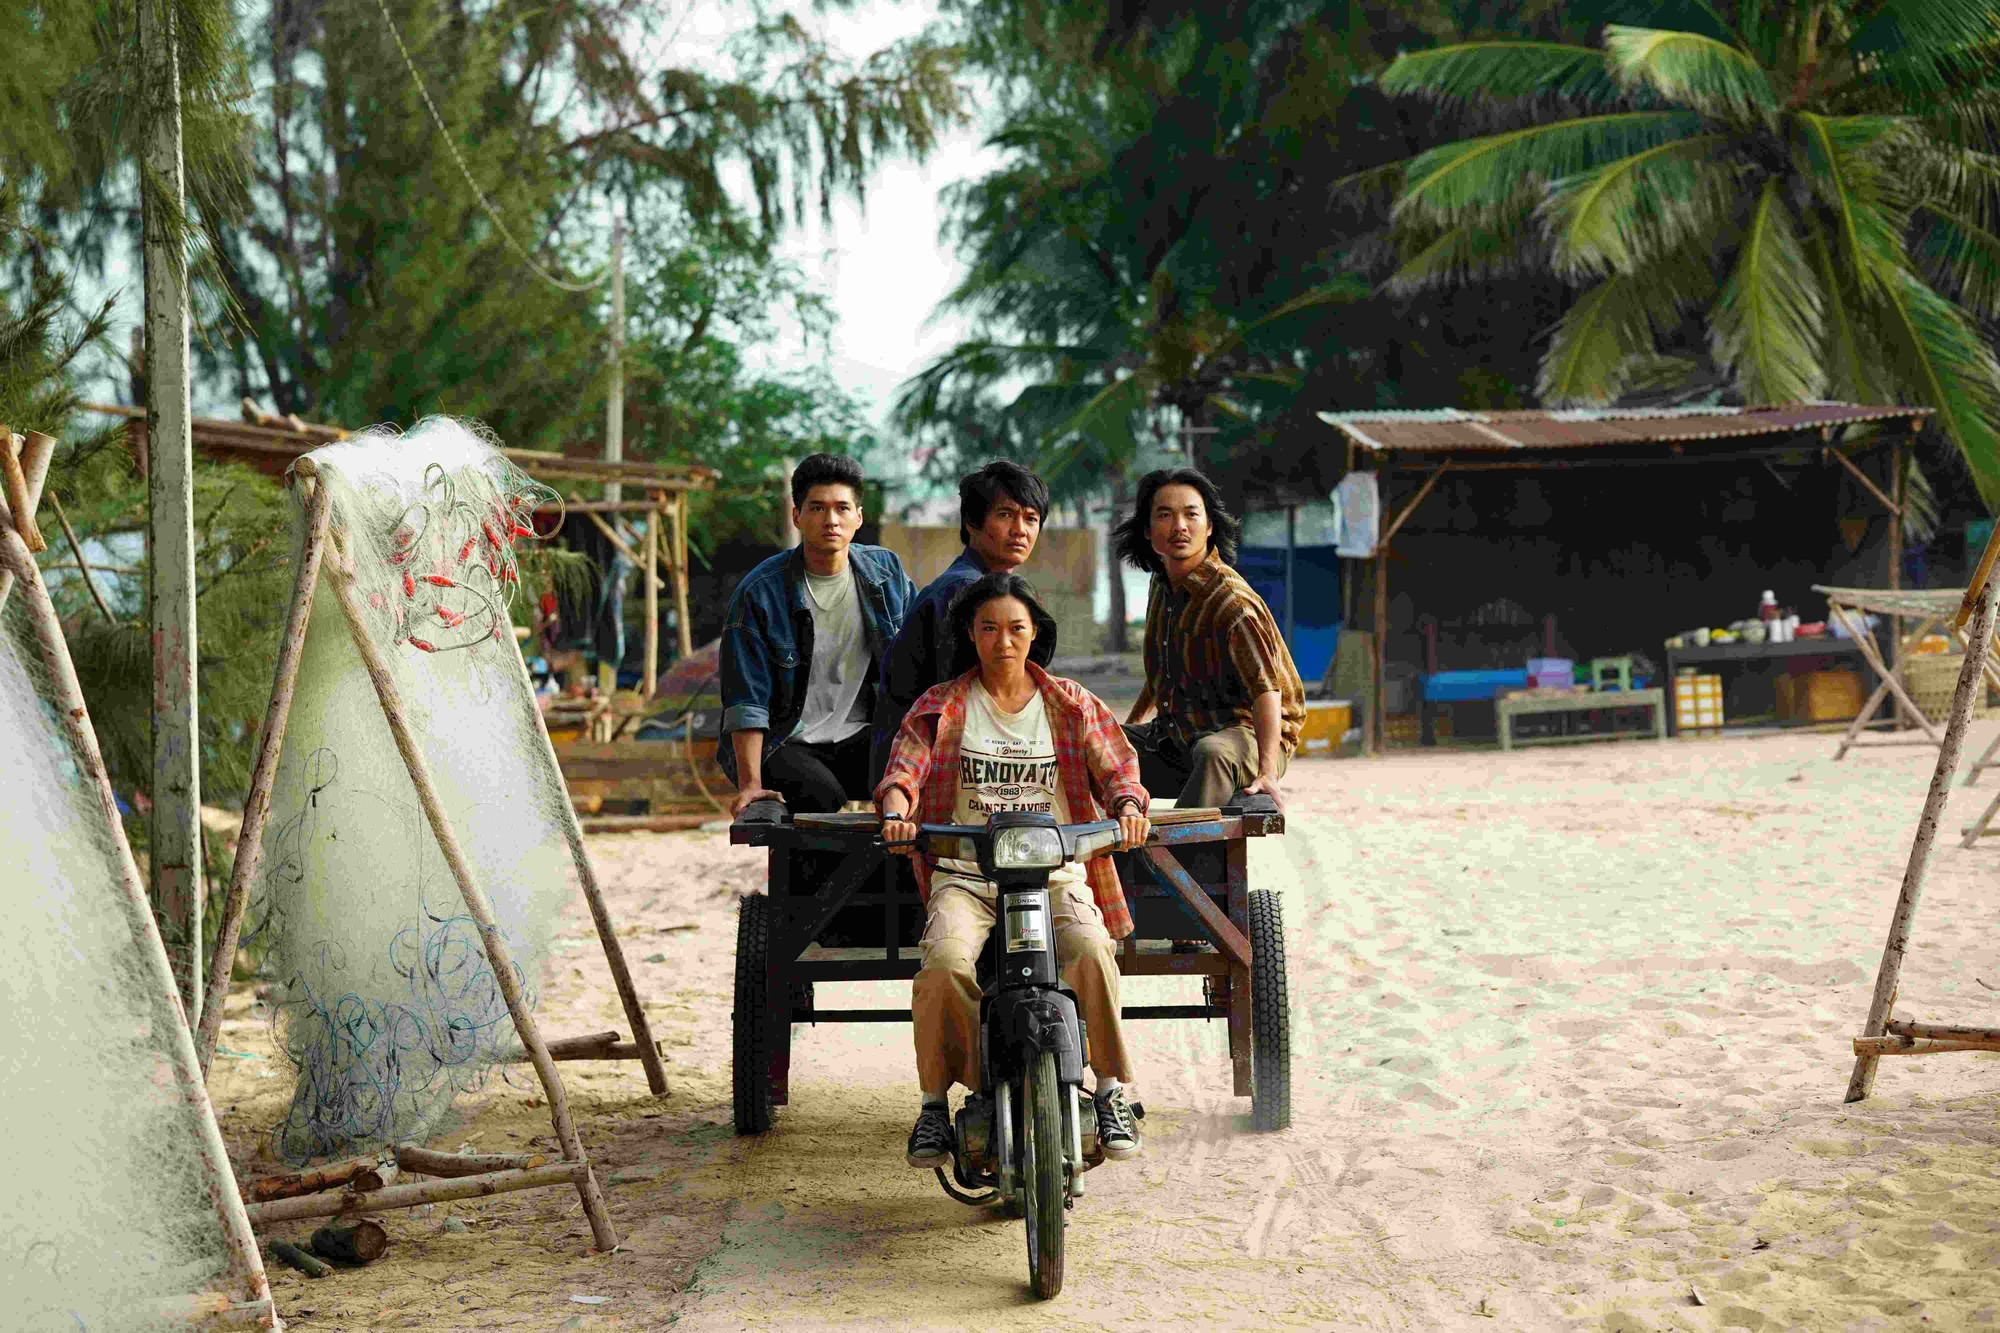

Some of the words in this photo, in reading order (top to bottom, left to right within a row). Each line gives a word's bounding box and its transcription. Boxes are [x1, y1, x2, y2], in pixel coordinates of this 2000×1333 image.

[1000, 787, 1020, 796] 1983
[968, 799, 1008, 813] CHANCE
[1013, 802, 1051, 813] FAVORS
